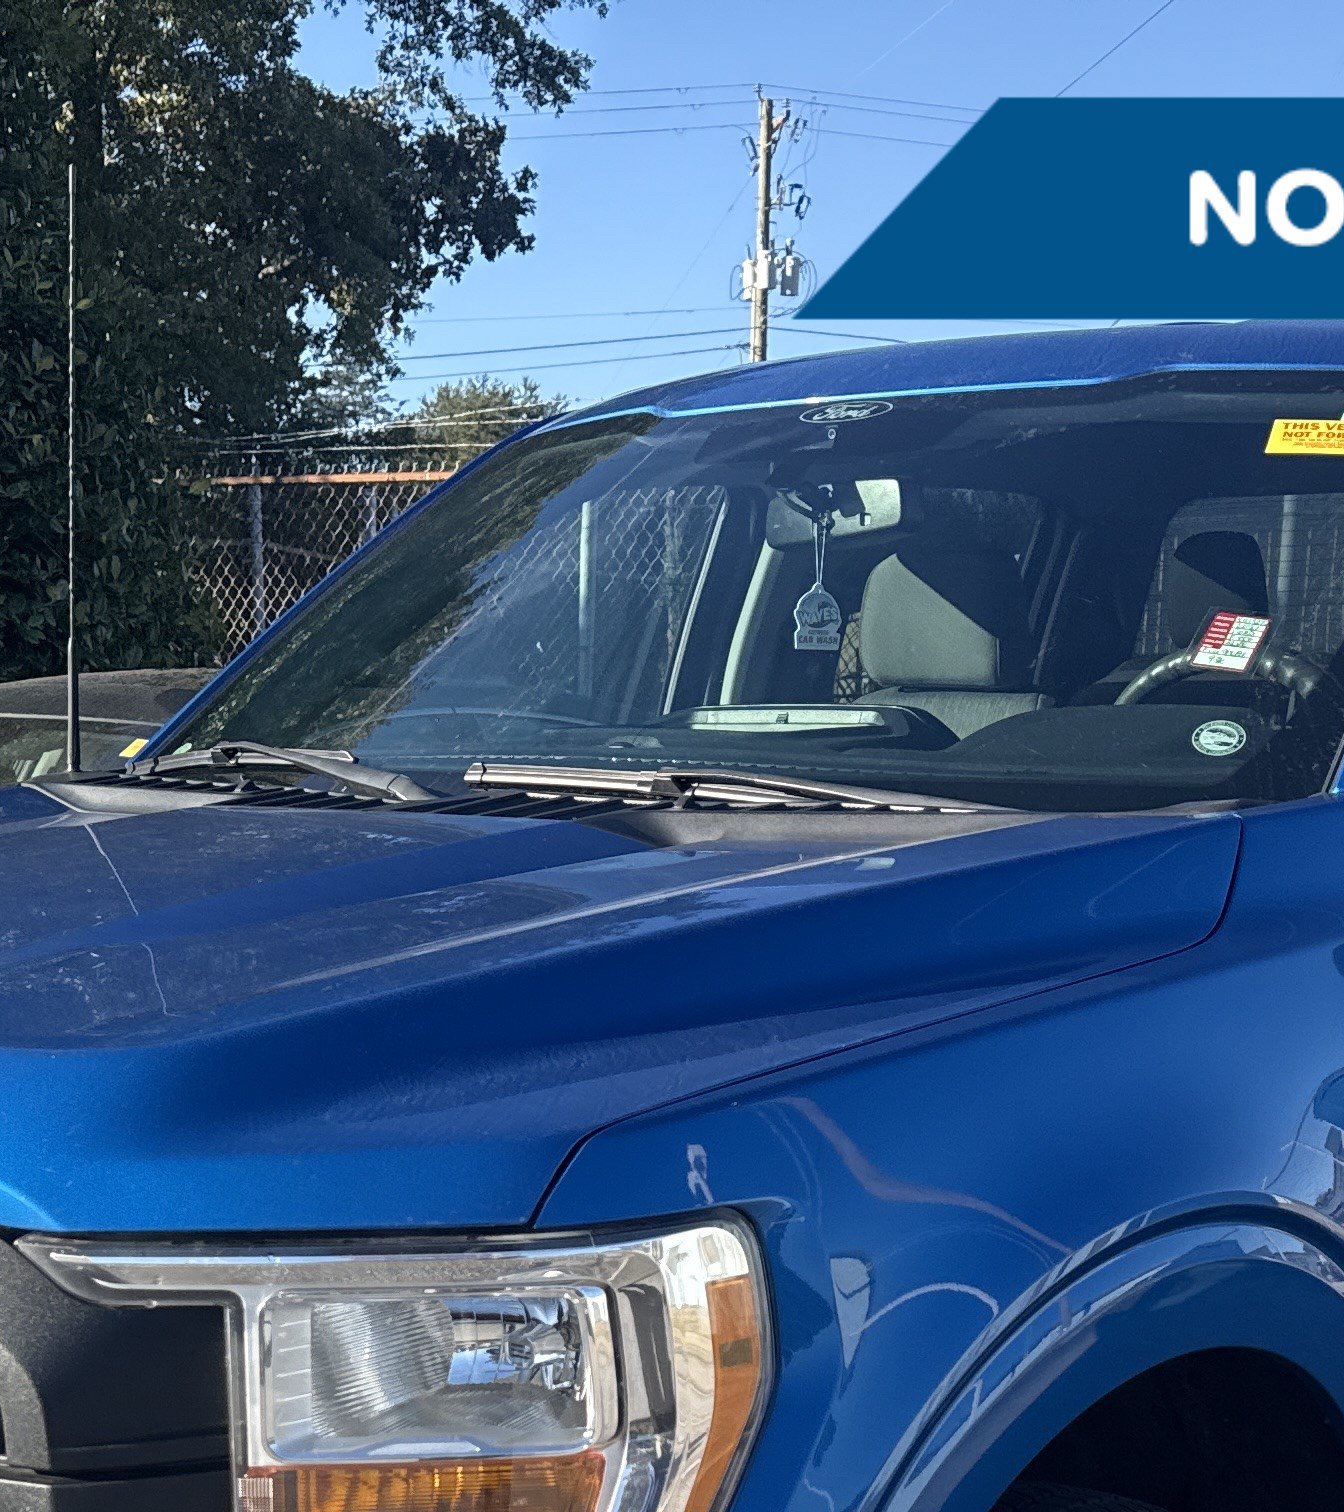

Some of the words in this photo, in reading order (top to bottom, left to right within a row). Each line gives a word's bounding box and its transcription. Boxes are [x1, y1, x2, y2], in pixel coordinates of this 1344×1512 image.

[1282, 421, 1320, 431] THIS
[798, 608, 838, 627] WAVES
[798, 635, 814, 643] CAR
[816, 635, 839, 644] WASH
